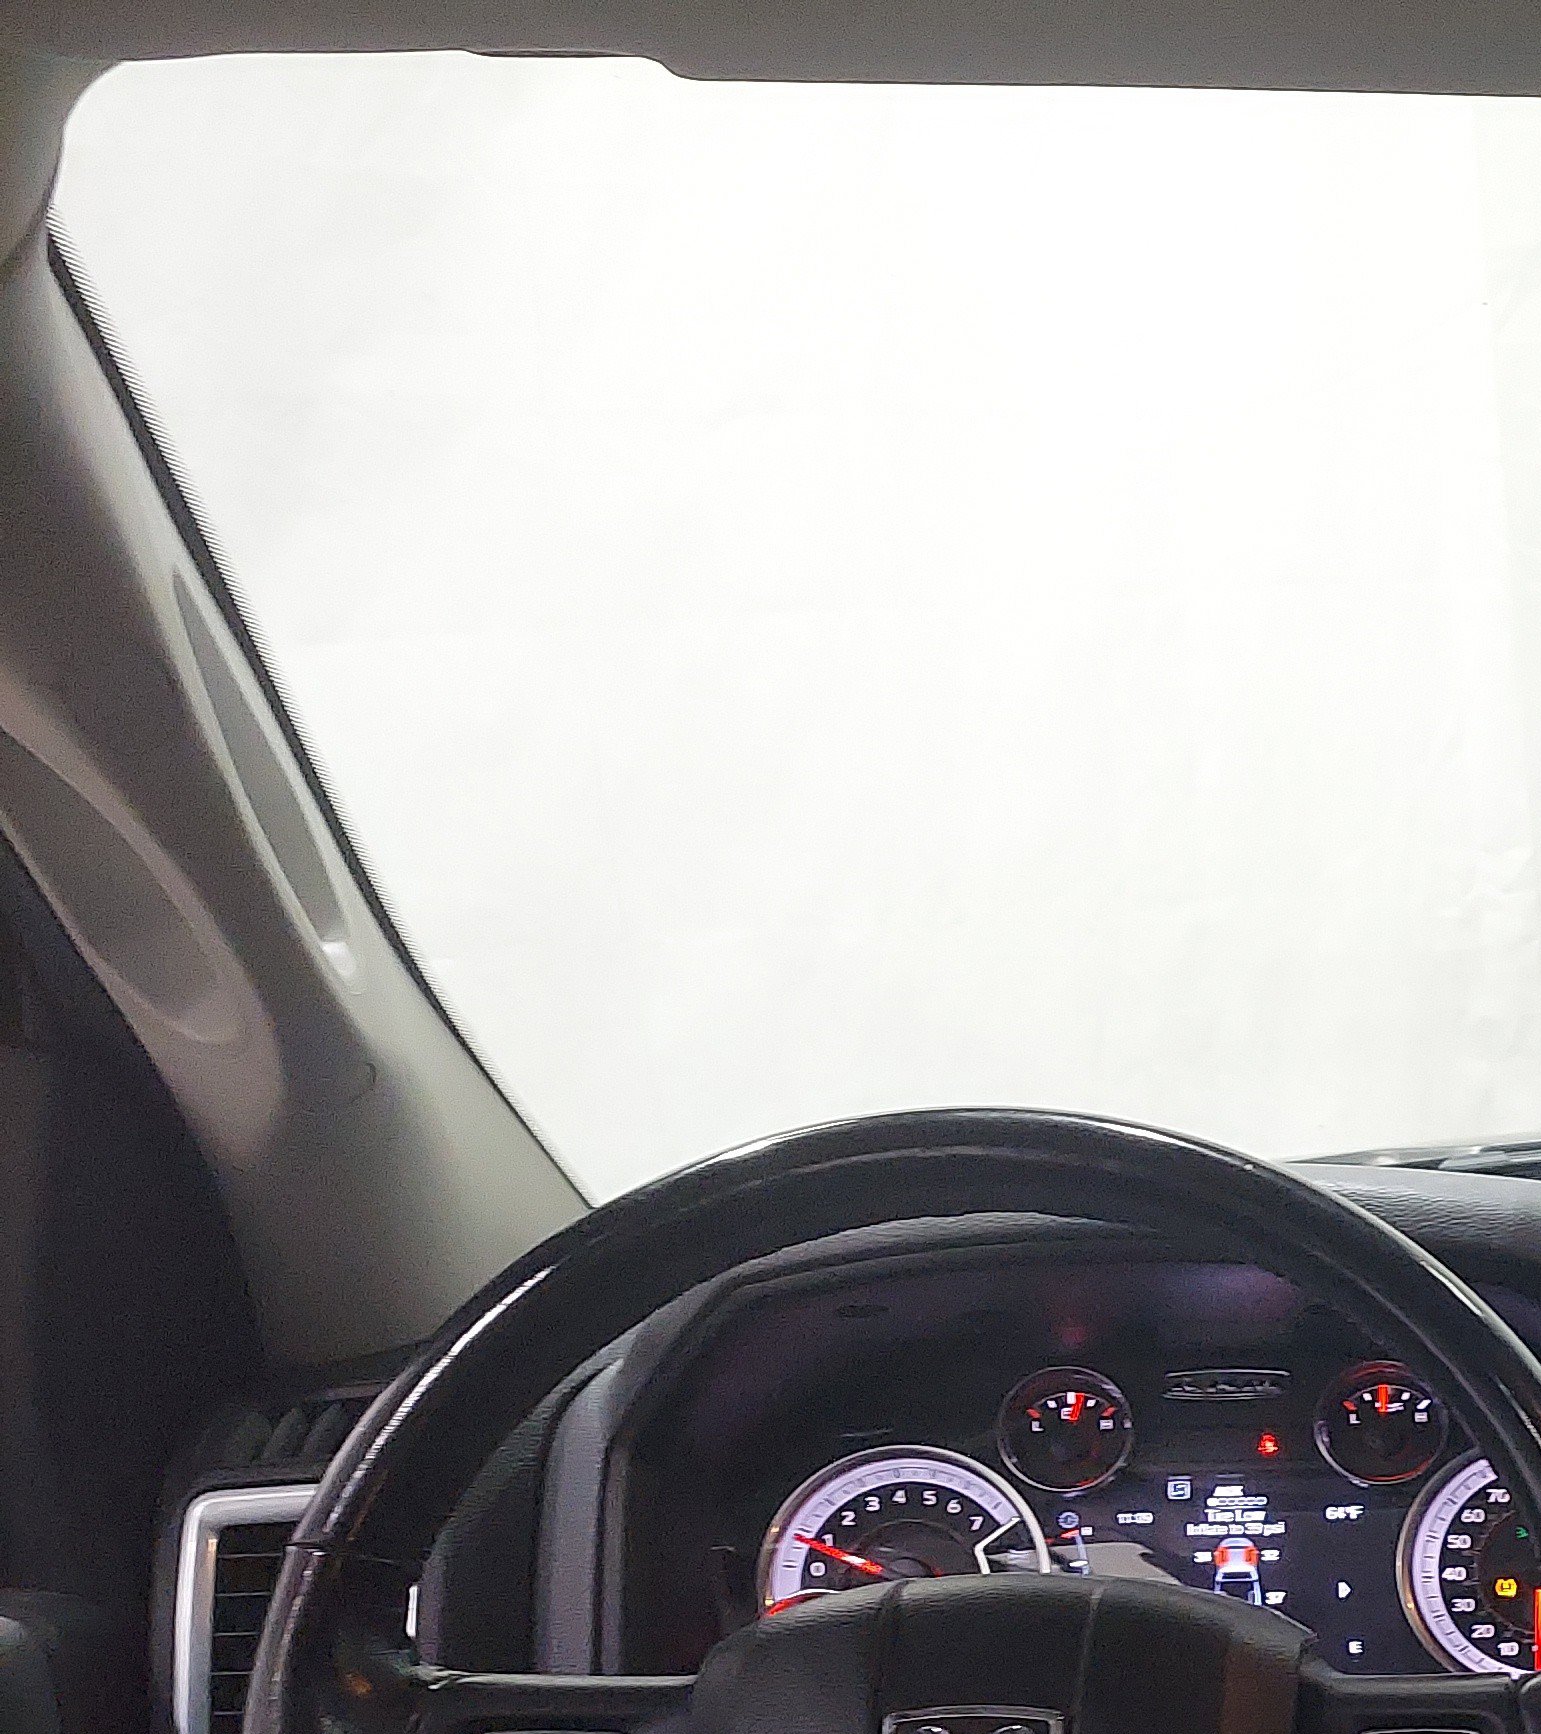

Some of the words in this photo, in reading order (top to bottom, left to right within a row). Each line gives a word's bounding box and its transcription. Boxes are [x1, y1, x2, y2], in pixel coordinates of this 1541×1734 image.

[892, 1489, 907, 1504] 4
[922, 1490, 938, 1505] 5
[1486, 1488, 1511, 1503] 70
[864, 1496, 881, 1511] 3
[946, 1499, 962, 1514] 6
[840, 1511, 857, 1526] 2
[968, 1515, 985, 1531] 7
[1460, 1509, 1486, 1523] 60
[1446, 1534, 1472, 1549] 50
[809, 1562, 826, 1577] 0
[1441, 1566, 1467, 1581] 40
[1450, 1598, 1476, 1612] 30
[1470, 1624, 1495, 1639] 20
[1497, 1641, 1520, 1656] 10
